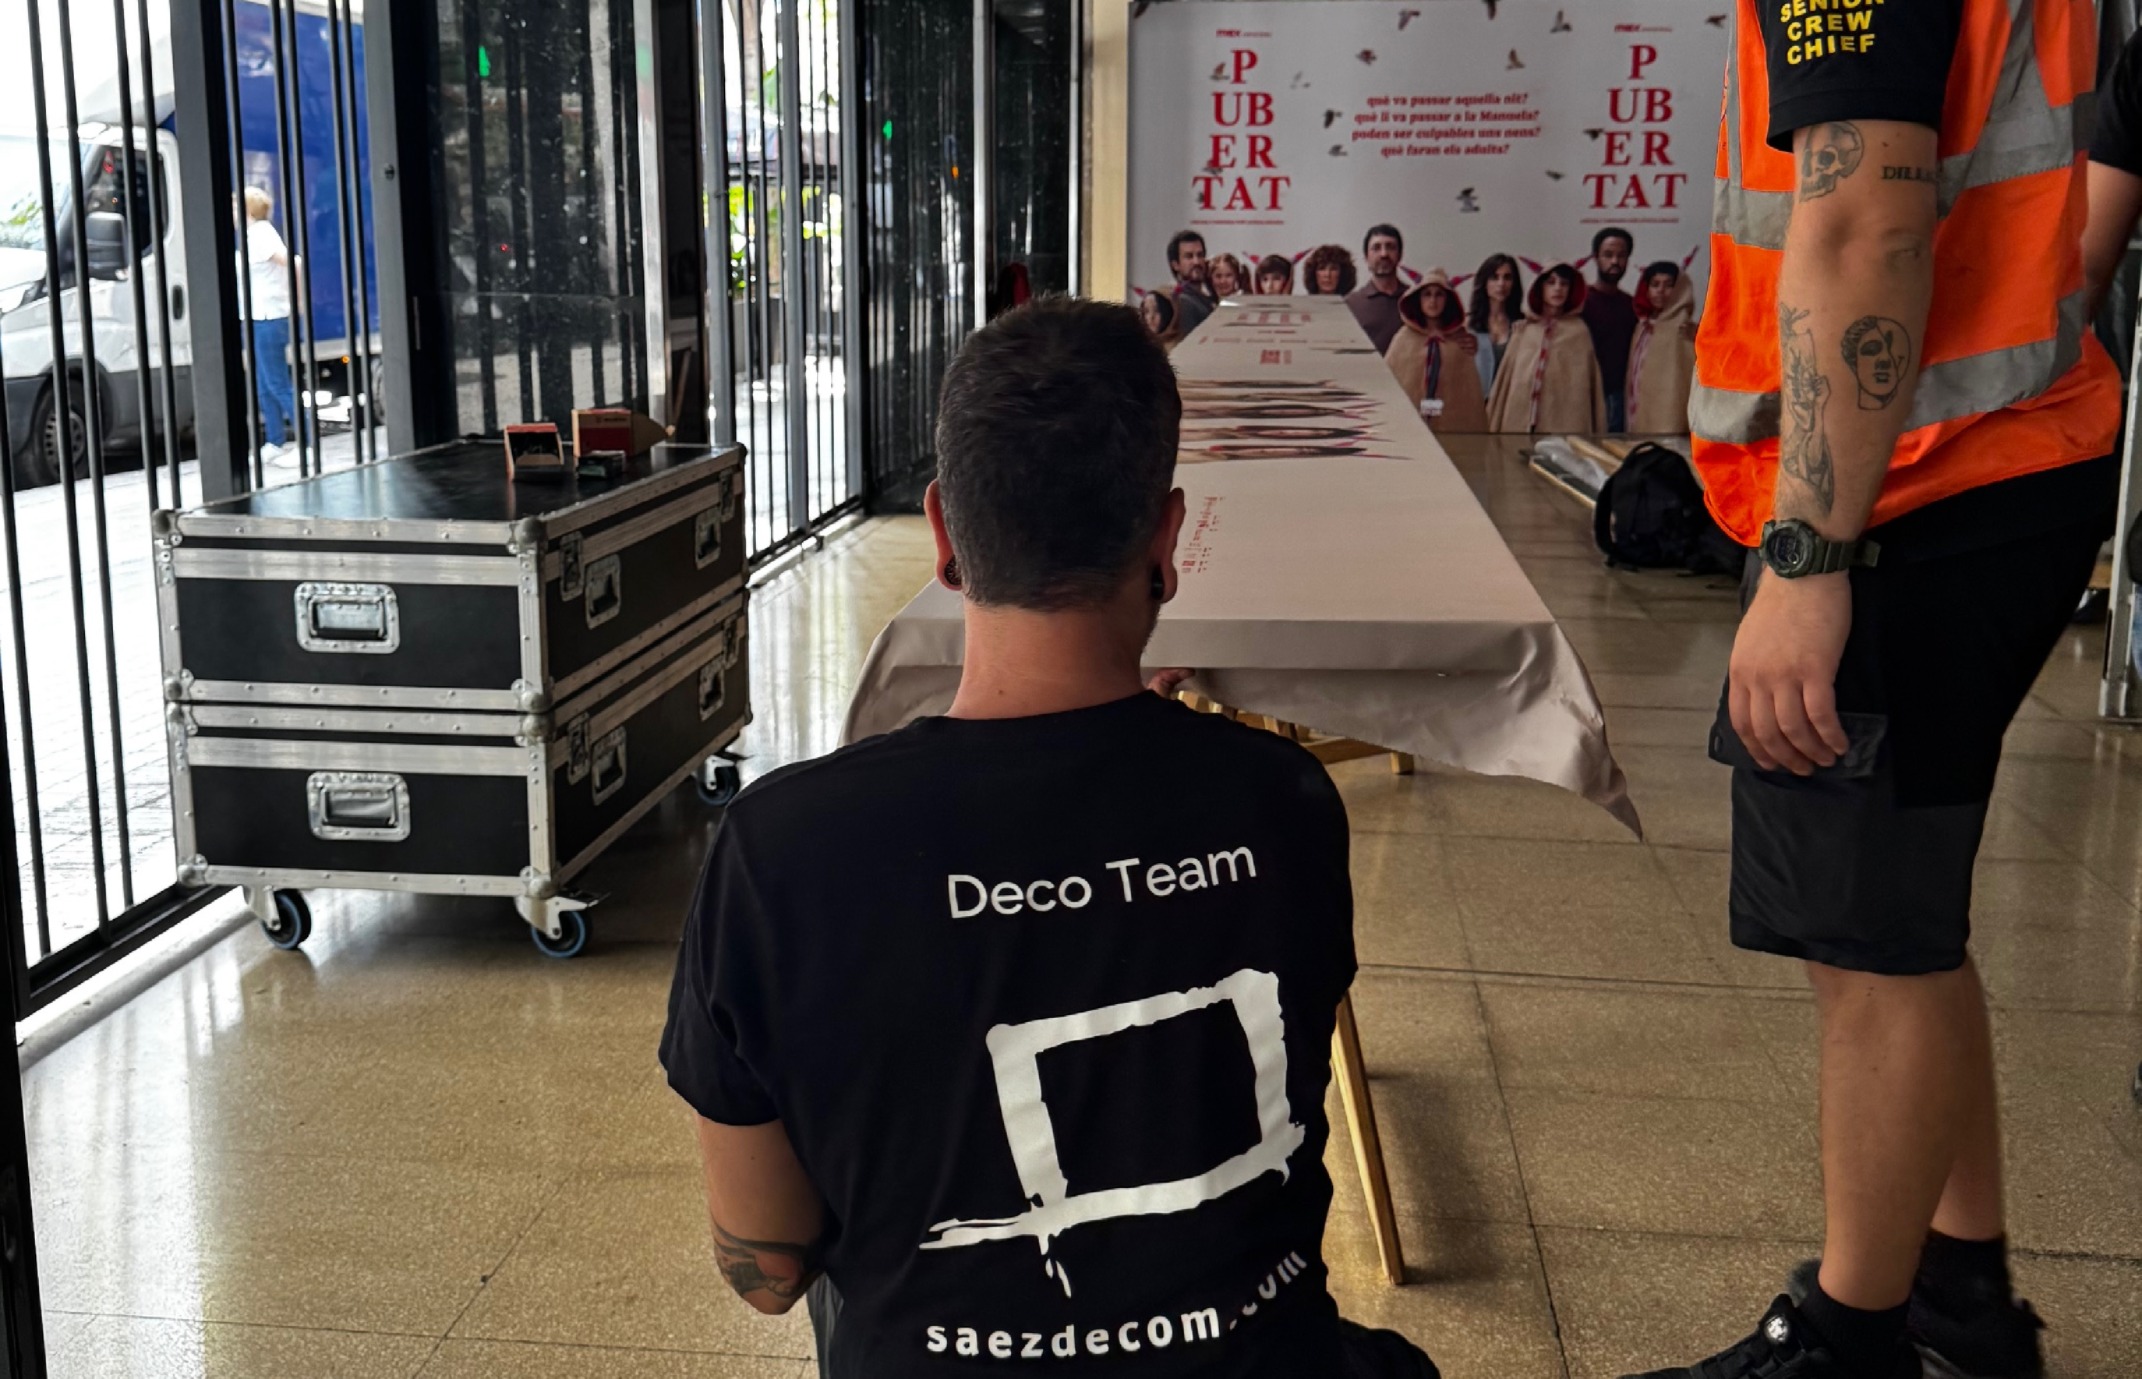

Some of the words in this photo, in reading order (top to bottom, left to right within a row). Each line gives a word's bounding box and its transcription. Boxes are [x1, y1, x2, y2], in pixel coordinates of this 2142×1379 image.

[1780, 0, 1884, 22] SENIO
[1787, 10, 1873, 41] CREW
[1230, 49, 1258, 84] P
[1628, 44, 1658, 80] P
[1787, 33, 1875, 65] CHIEF
[1211, 91, 1274, 127] UB
[1380, 111, 1390, 122] li
[1392, 112, 1407, 122] va
[1409, 112, 1452, 124] passar
[1453, 113, 1462, 122] a
[1464, 111, 1477, 122] la
[1479, 110, 1540, 122] Manuela?
[1393, 96, 1408, 106] va
[1410, 96, 1452, 108] passar
[1454, 93, 1500, 107] aquella
[1504, 92, 1529, 105] nit?
[1607, 86, 1673, 123] UB
[1209, 134, 1277, 169] ER
[1352, 128, 1390, 142] poden
[1393, 129, 1413, 139] ser
[1416, 127, 1475, 141] culpables
[1478, 129, 1501, 139] uns
[1504, 127, 1541, 139] nens?
[1406, 144, 1441, 156] faran
[1443, 144, 1461, 156] els
[1464, 143, 1510, 156] adults?
[1601, 130, 1675, 166] ER
[1192, 175, 1291, 210] TAT
[1582, 173, 1688, 209] TAT
[948, 874, 1092, 918] Deco
[1105, 846, 1257, 902] Team
